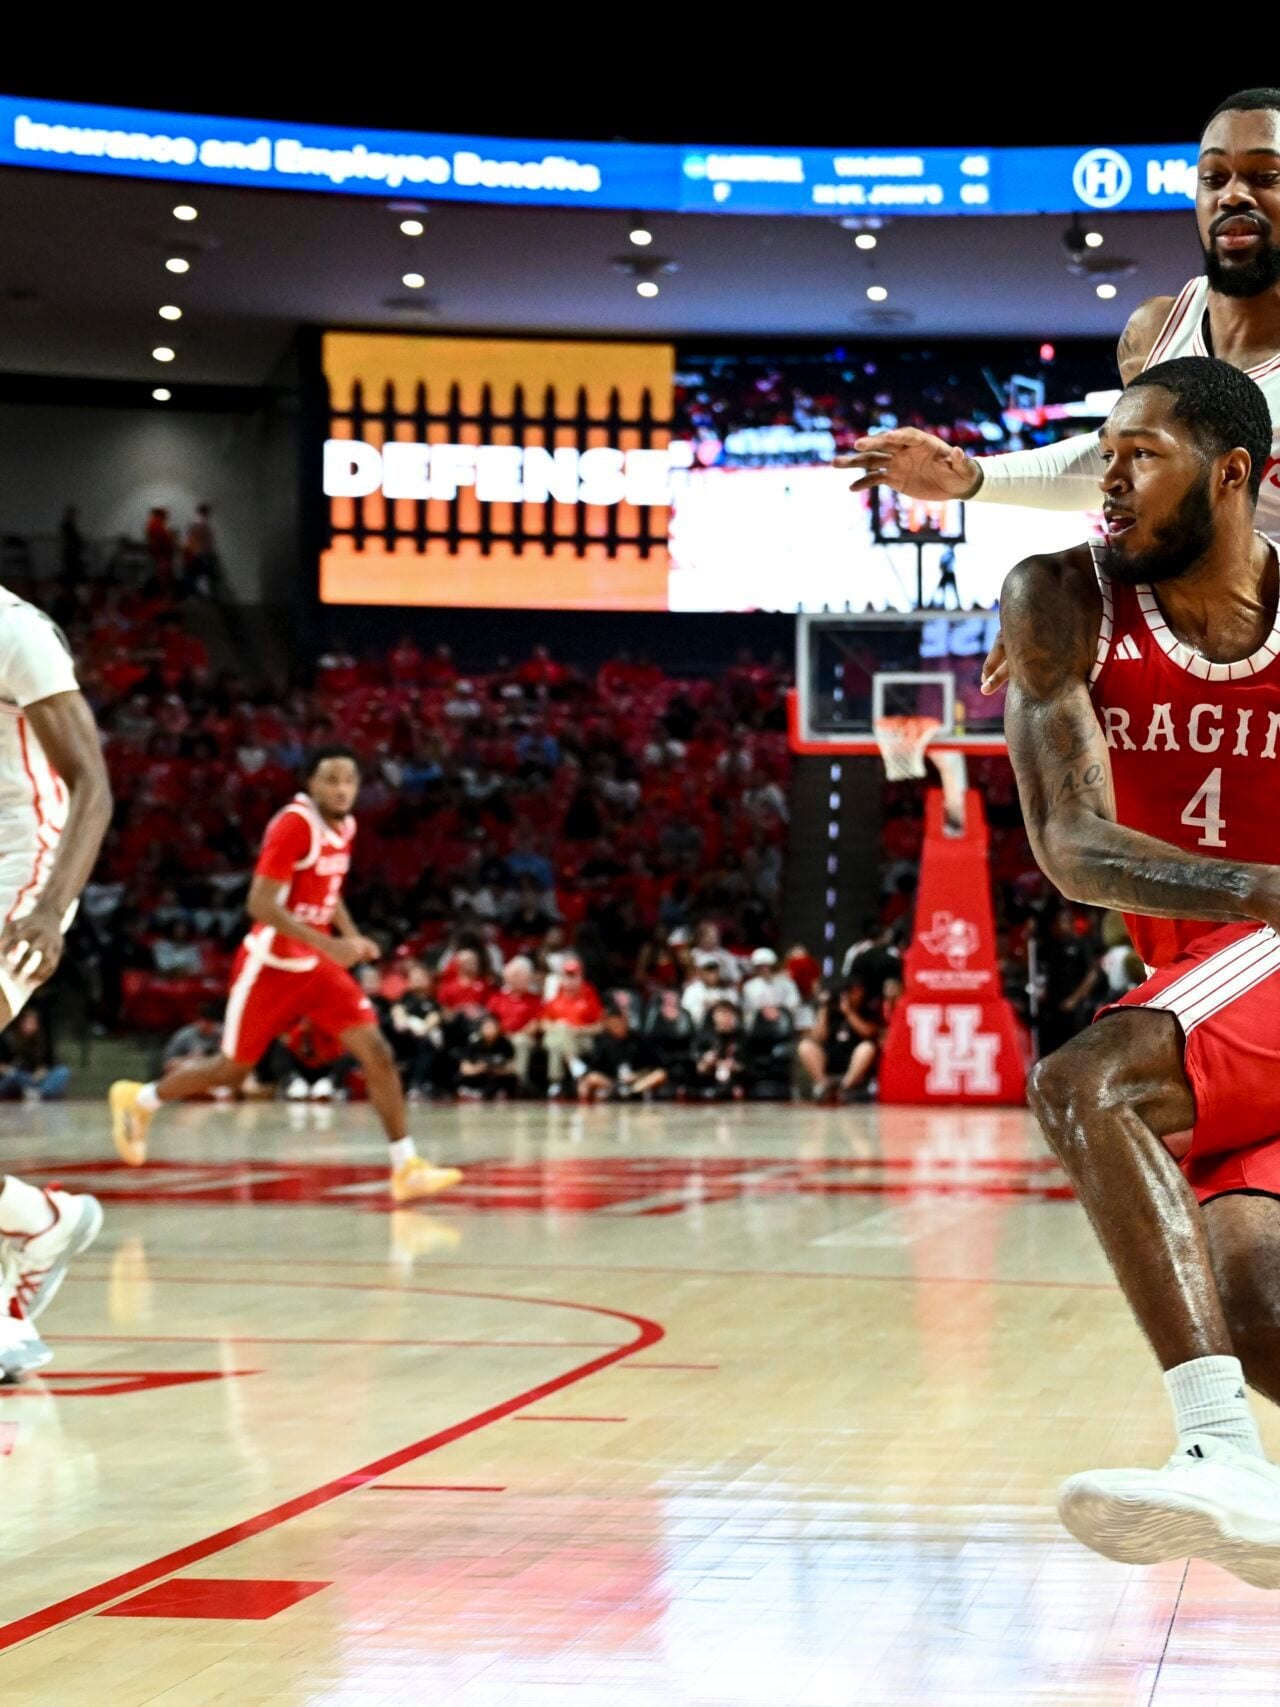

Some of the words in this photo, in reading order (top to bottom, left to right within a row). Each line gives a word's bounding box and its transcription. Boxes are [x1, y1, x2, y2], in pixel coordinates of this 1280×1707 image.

[323, 439, 675, 505] DEFENSE
[1181, 768, 1227, 848] 4
[907, 1004, 1000, 1095] UH
